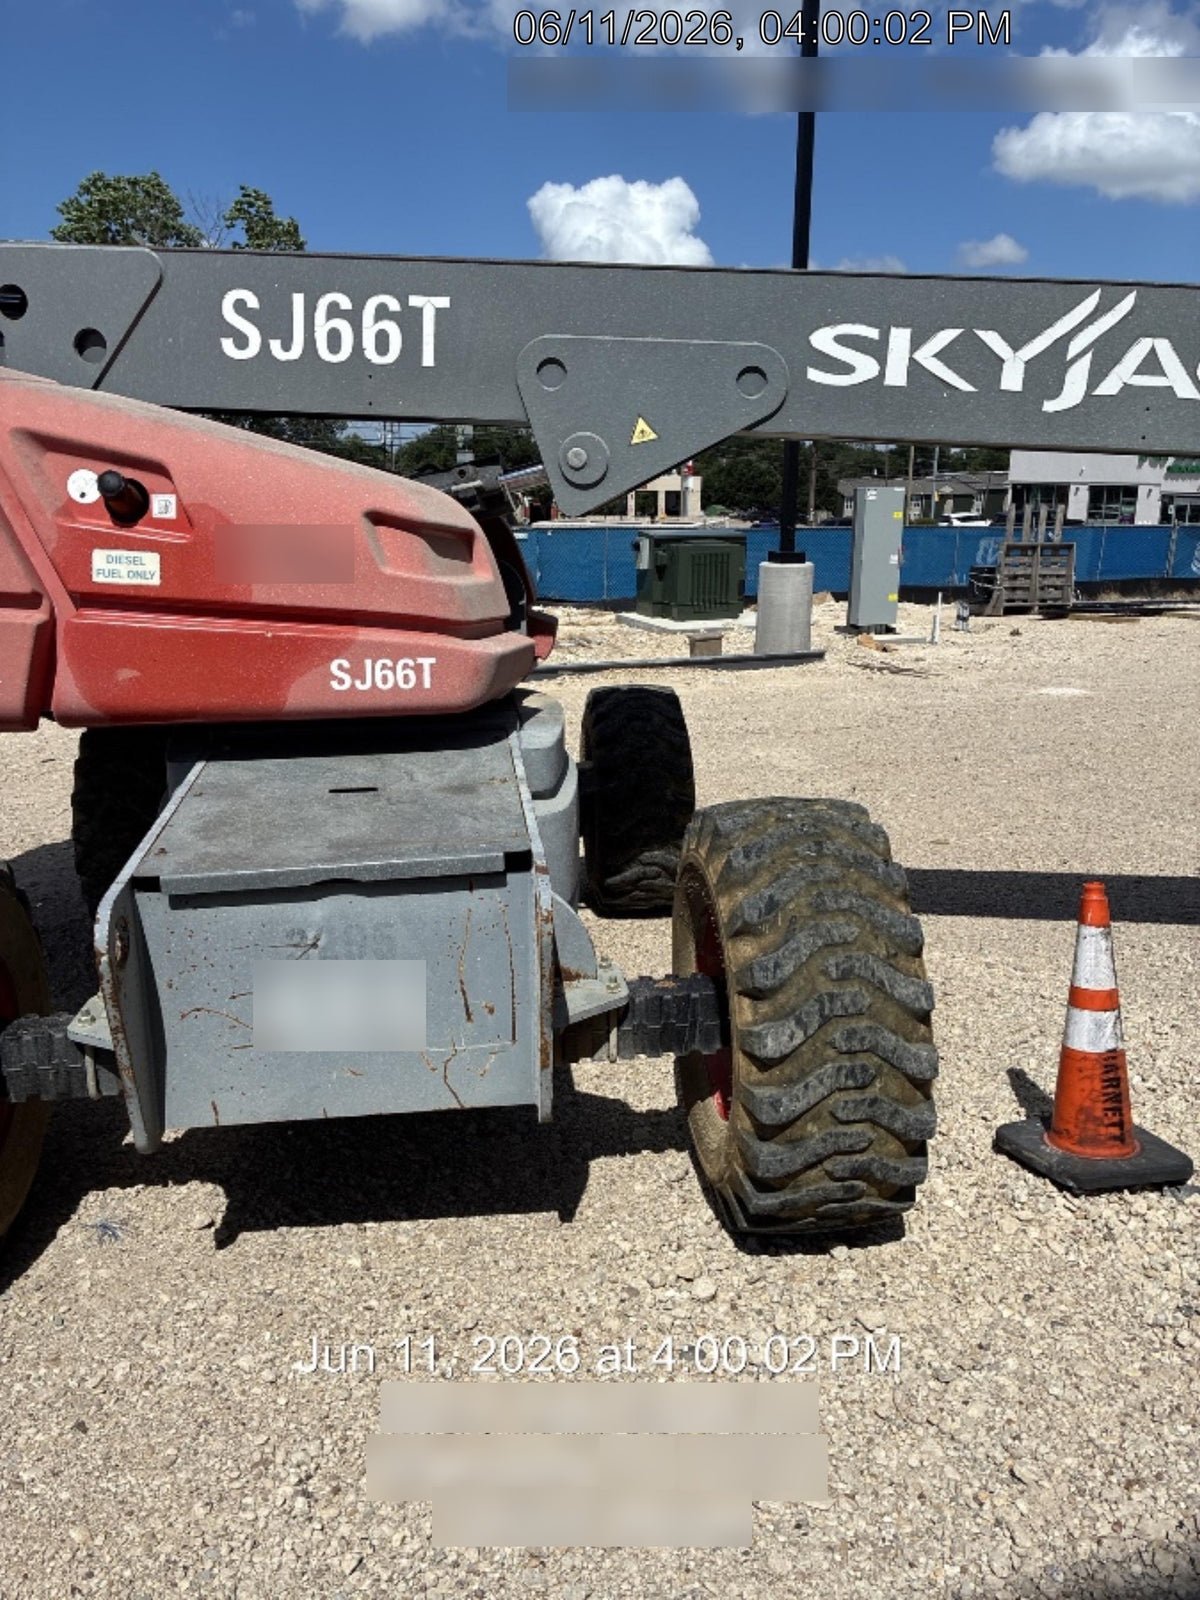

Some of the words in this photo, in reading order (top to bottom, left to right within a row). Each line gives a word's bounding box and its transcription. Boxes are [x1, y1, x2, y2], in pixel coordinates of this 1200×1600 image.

[219, 288, 451, 367] SJ66T
[806, 287, 1200, 413] SKYJA
[96, 568, 125, 579] FUEL
[127, 570, 157, 580] ONLY
[105, 554, 146, 566] DIESEL
[329, 657, 437, 691] SJ66T
